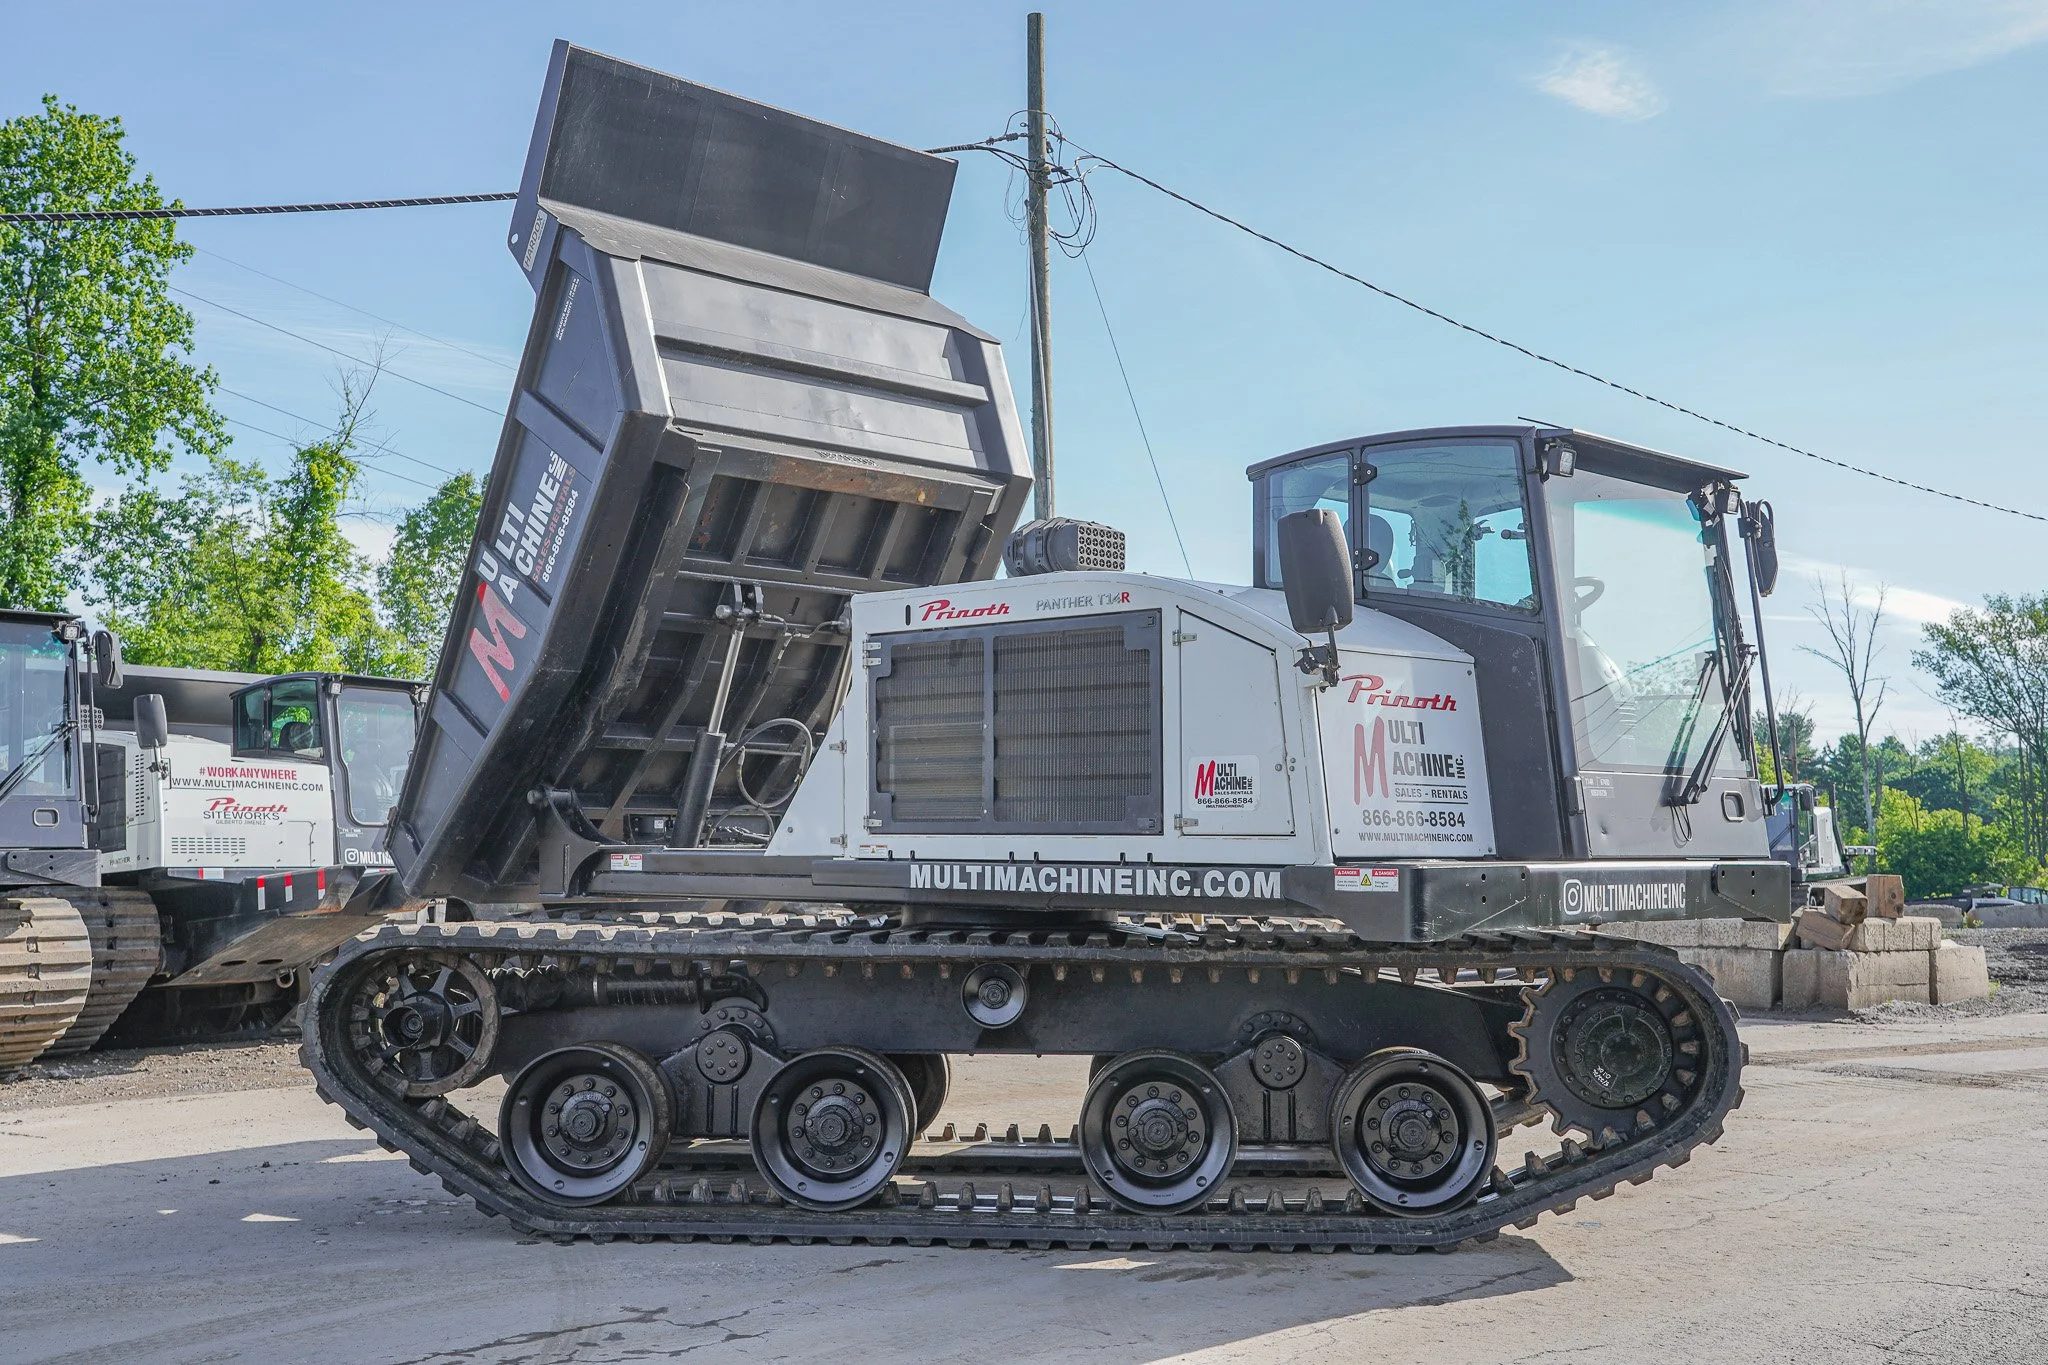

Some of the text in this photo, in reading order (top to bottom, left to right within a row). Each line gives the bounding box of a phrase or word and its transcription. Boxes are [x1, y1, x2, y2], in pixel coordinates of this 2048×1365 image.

[524, 216, 543, 267] HARDOX
[542, 489, 579, 583] 866-866-8584
[918, 599, 1010, 622] Prinoth
[1036, 594, 1093, 611] PANTHER
[1341, 674, 1457, 711] Prinoth
[1455, 754, 1466, 779] INC.
[172, 777, 324, 792] WWW.MULTIMACHINEINC.COM
[1394, 788, 1422, 798] SALES
[1431, 789, 1468, 800] RENTALS
[206, 797, 289, 813] Prinoth
[1197, 797, 1253, 805] 866-866-8584
[203, 810, 280, 821] SITEWORKS
[1362, 809, 1466, 828] 866-866-8584
[1358, 832, 1474, 842] WWW.MULTIMACHINEINC.COM
[910, 864, 1281, 899] MULTIMACHINEINC.COM
[1584, 883, 1686, 913] MULTIMACHINEINC
